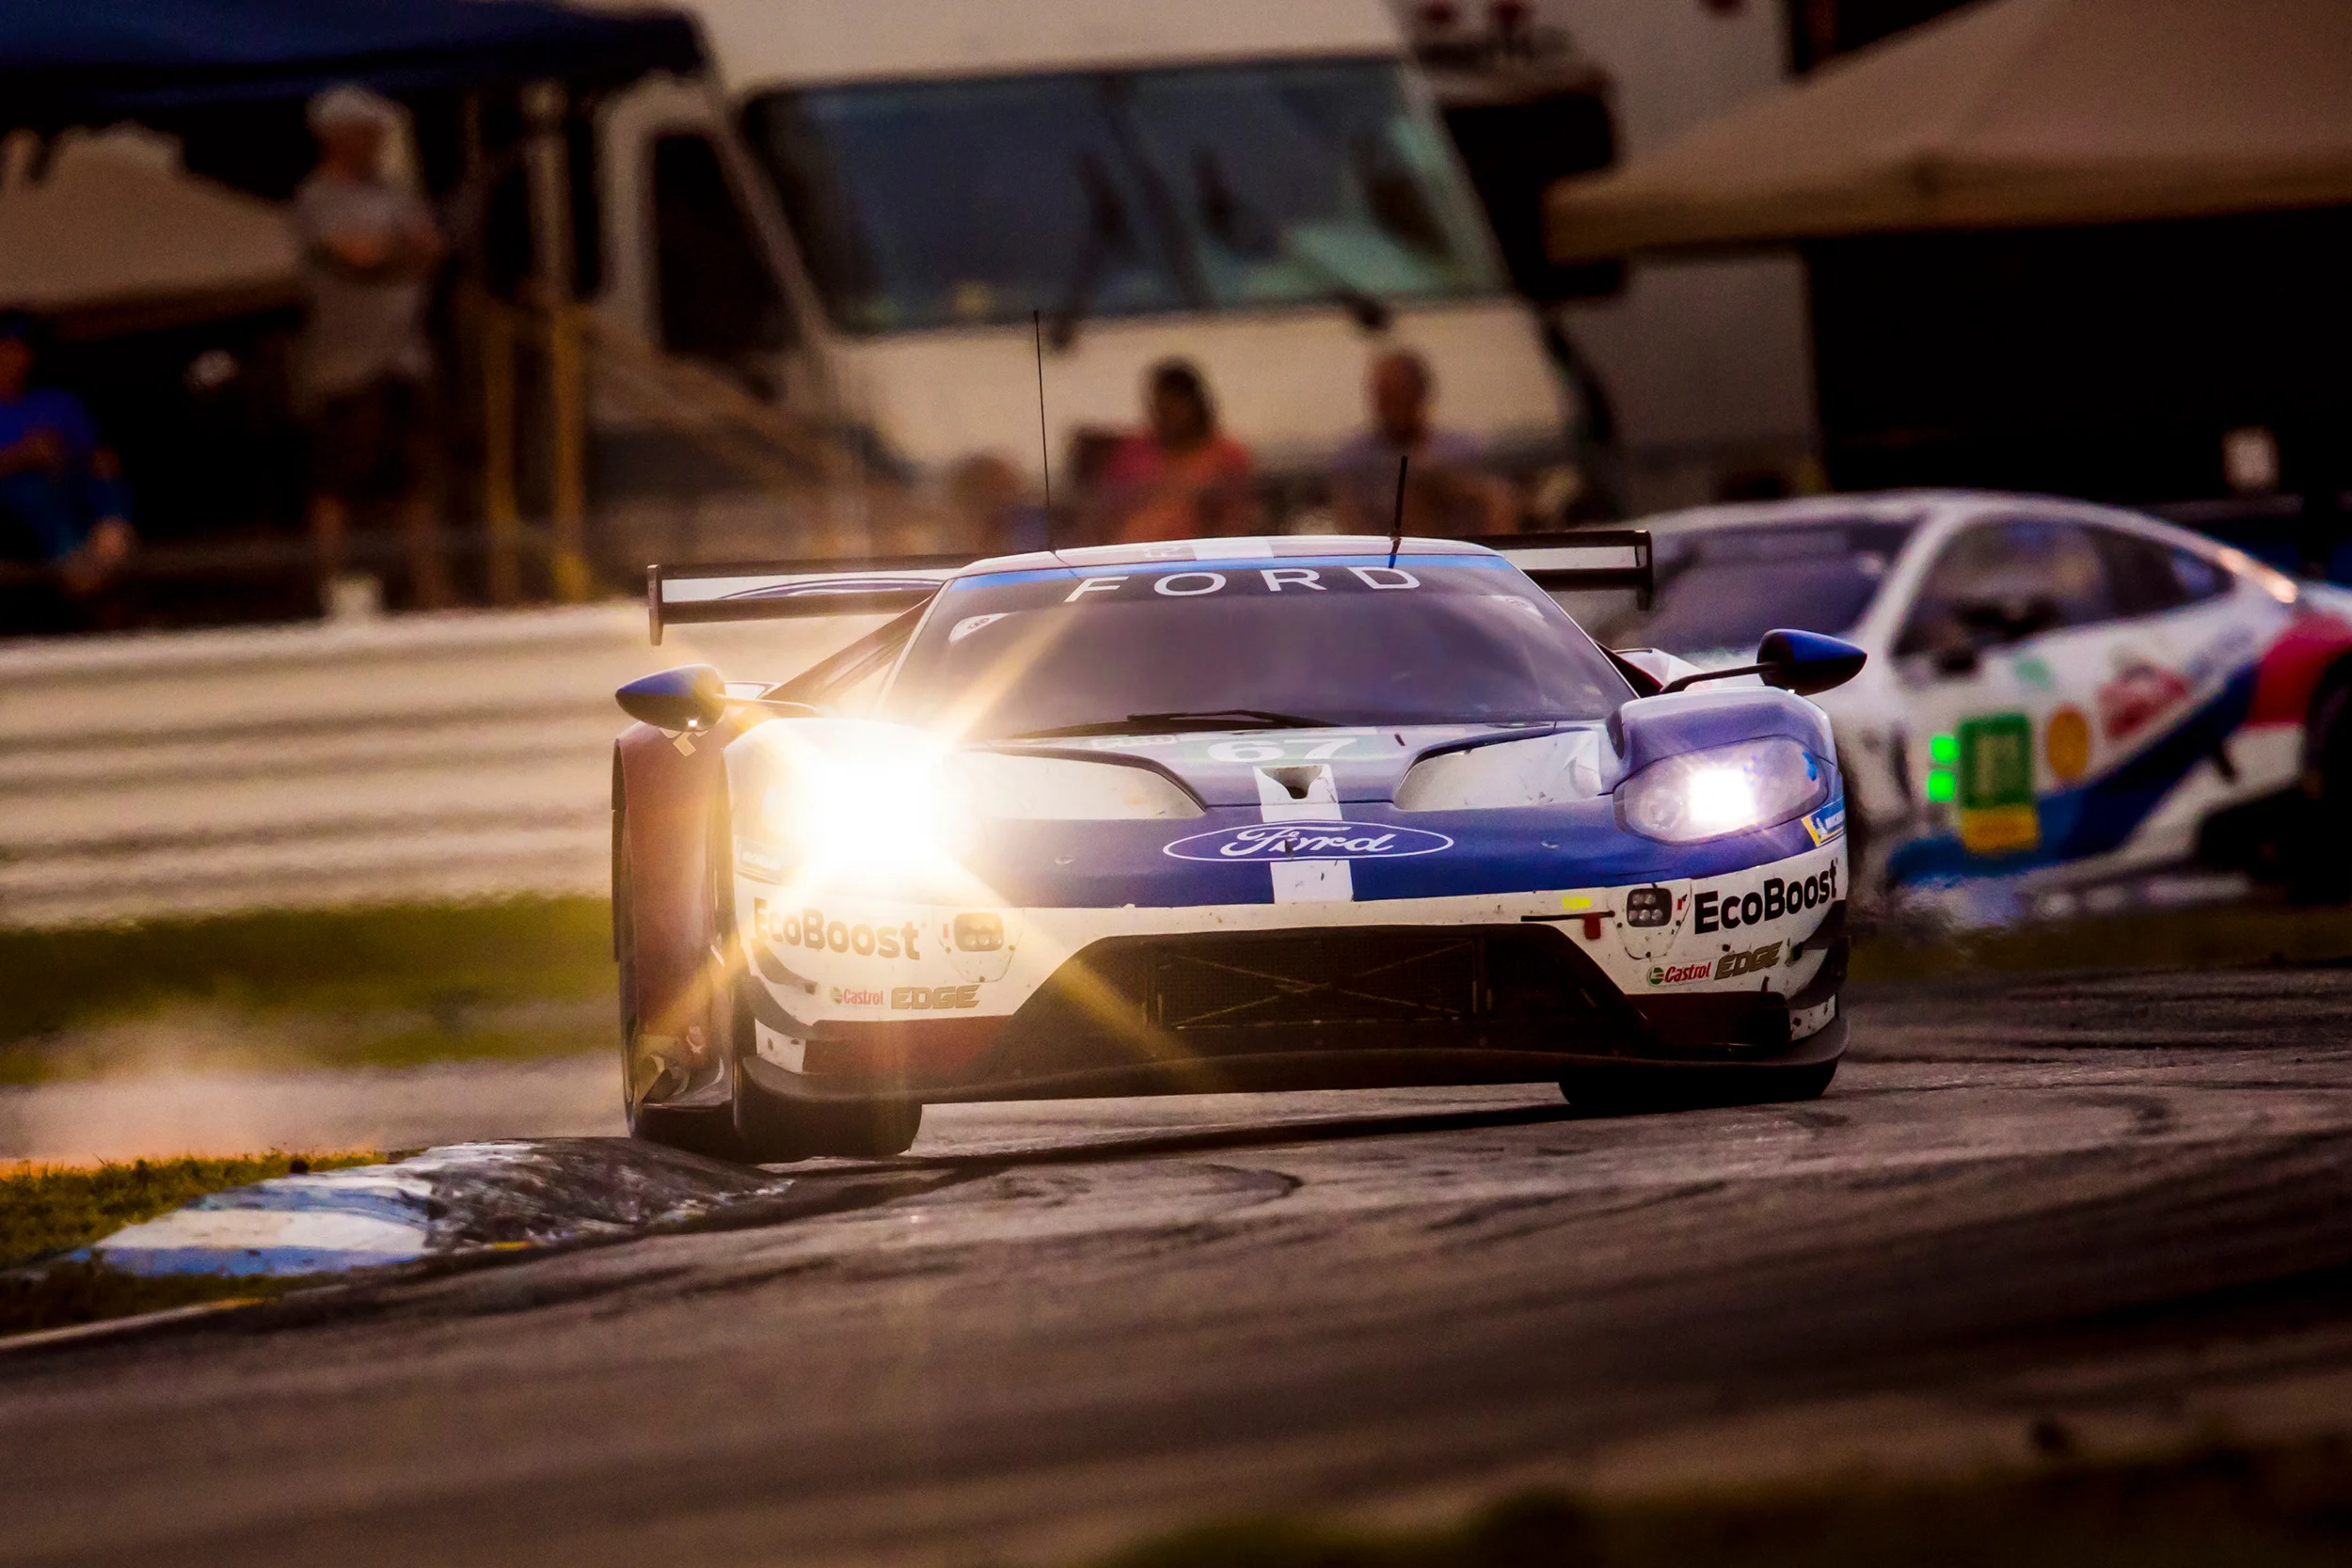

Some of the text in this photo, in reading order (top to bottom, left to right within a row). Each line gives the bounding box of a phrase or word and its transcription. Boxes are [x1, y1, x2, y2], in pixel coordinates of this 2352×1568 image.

[1063, 566, 1421, 603] FORD
[1207, 736, 1358, 762] 67
[1220, 826, 1397, 856] Ford
[1694, 859, 1837, 935] EcoBoost
[754, 896, 921, 960] EcoBoost
[1664, 941, 1784, 984] Castrol EDGE
[842, 984, 981, 1010] Castrol EDGE
